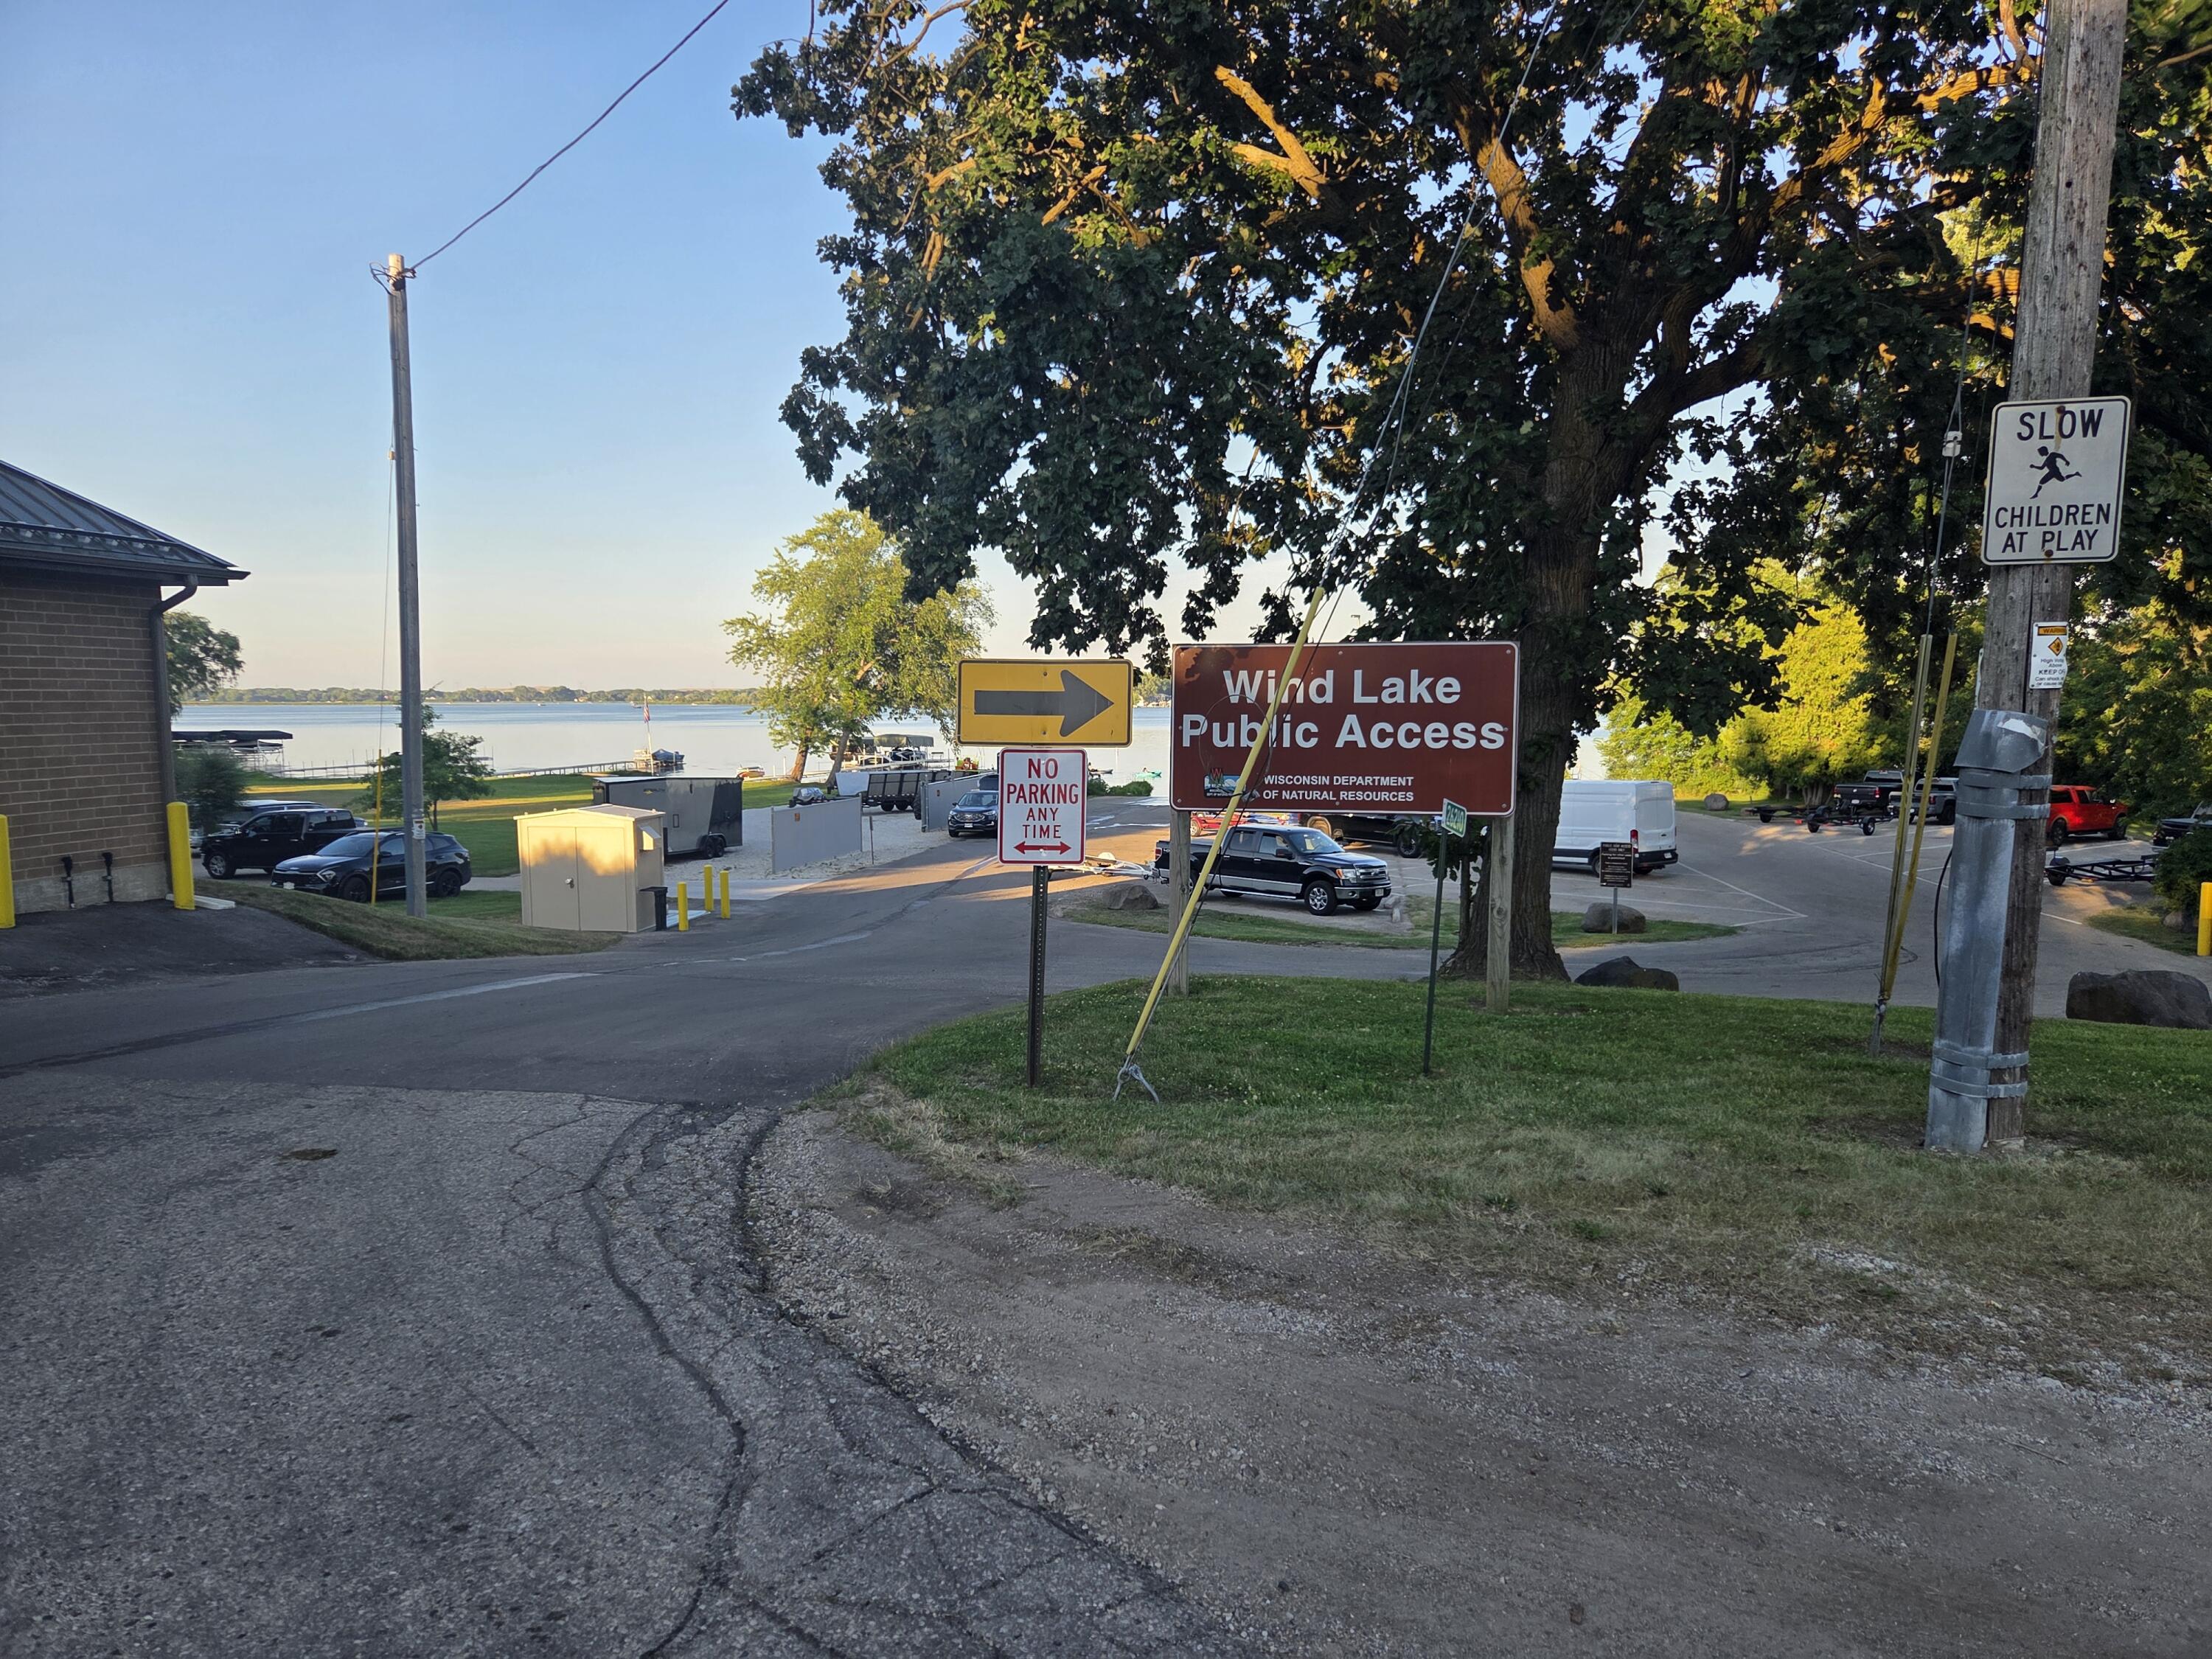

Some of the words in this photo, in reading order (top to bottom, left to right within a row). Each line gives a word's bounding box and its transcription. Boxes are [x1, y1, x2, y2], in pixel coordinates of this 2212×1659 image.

[2017, 408, 2104, 442] SLOW
[1994, 503, 2111, 529] CHILDREN
[2001, 531, 2028, 554] AT
[2041, 529, 2099, 552] PLAY
[1222, 669, 1334, 704] Wind
[1354, 669, 1461, 703] Lake
[1182, 714, 1318, 748] Public
[1335, 714, 1505, 749] Access
[1028, 758, 1058, 779] NO
[1264, 775, 1329, 785] WISCONSIN
[1333, 776, 1414, 786] DEPARTMENT
[1006, 783, 1079, 804] PARKING
[1262, 790, 1279, 799] OF
[1281, 790, 1336, 800] NATURAL
[1340, 791, 1414, 801] RESOURCES
[1026, 807, 1059, 821] ANY
[1022, 824, 1062, 838] TIME
